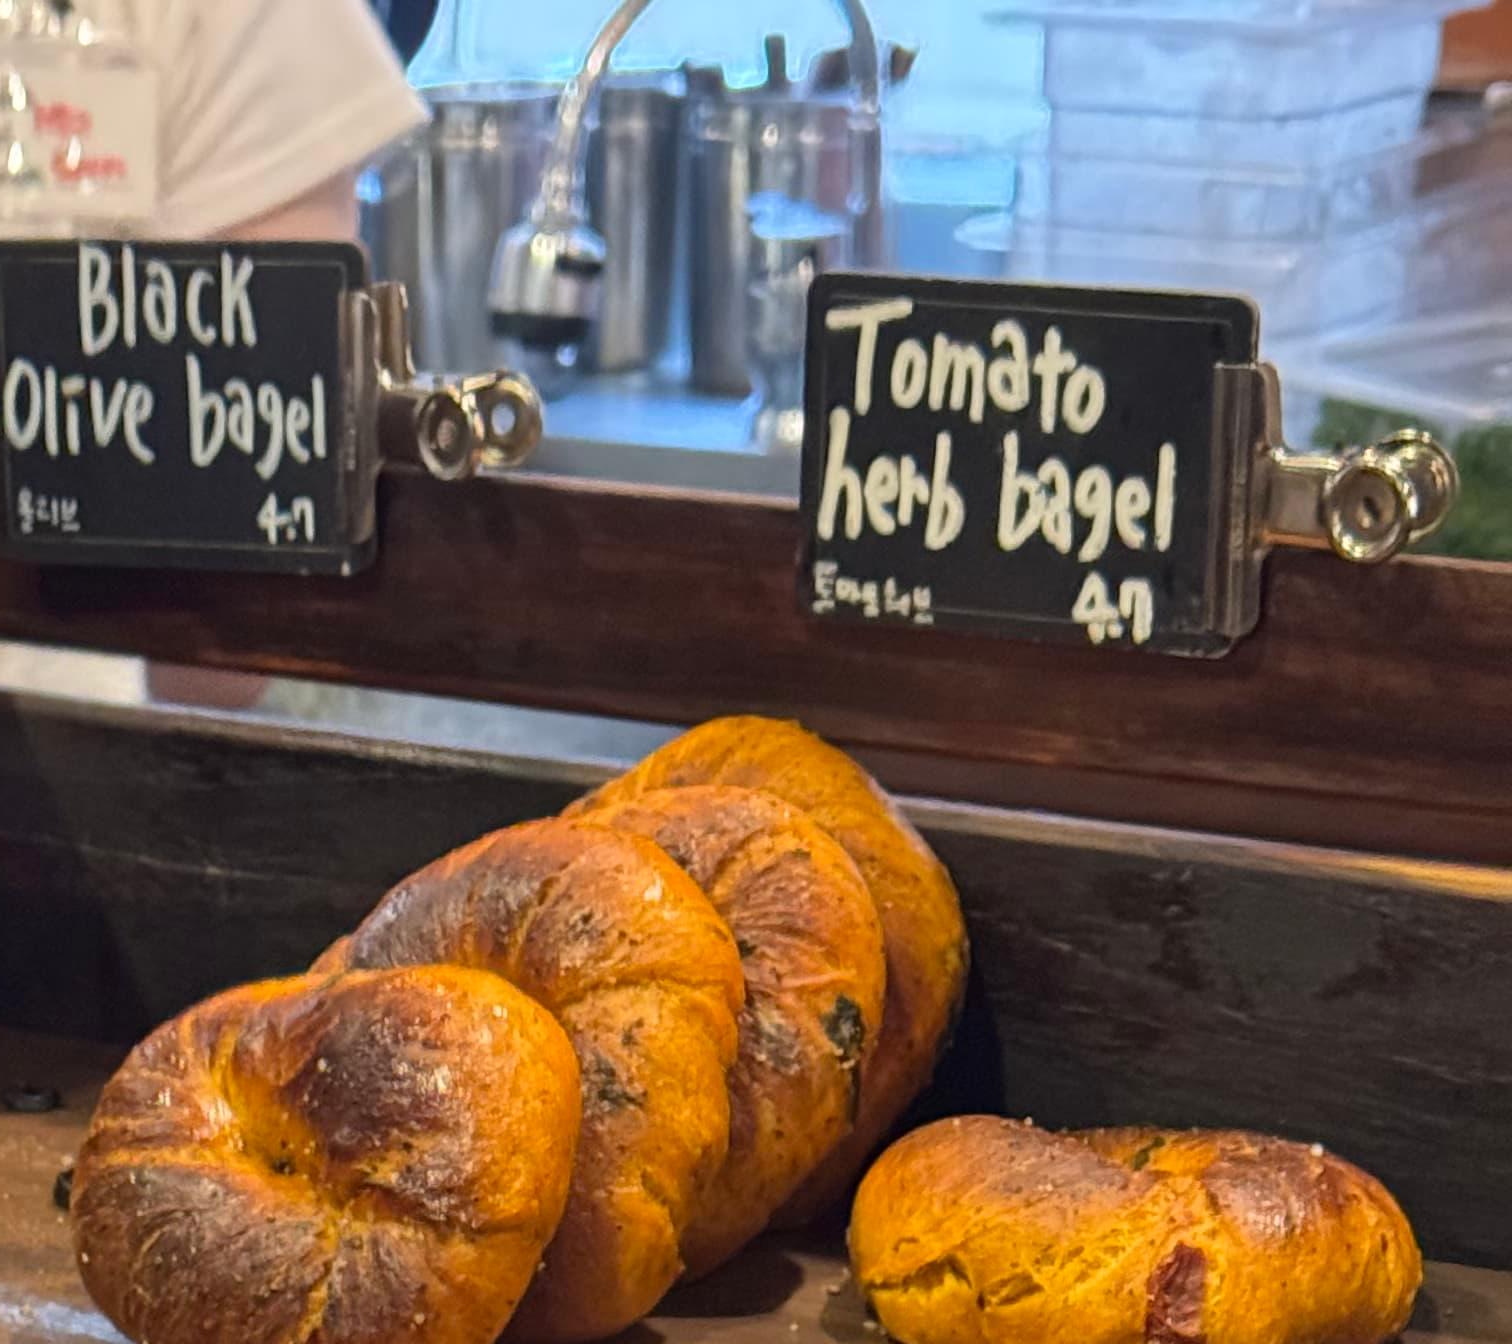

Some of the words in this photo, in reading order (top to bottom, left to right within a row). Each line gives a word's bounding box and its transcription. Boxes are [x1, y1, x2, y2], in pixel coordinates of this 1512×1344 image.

[78, 243, 258, 356] Black
[2, 359, 155, 464] Olive
[186, 354, 327, 480] bagel
[825, 297, 1108, 435] Tomato
[816, 406, 966, 551] herb
[996, 430, 1178, 563] bagel
[1070, 570, 1155, 645] 4.7
